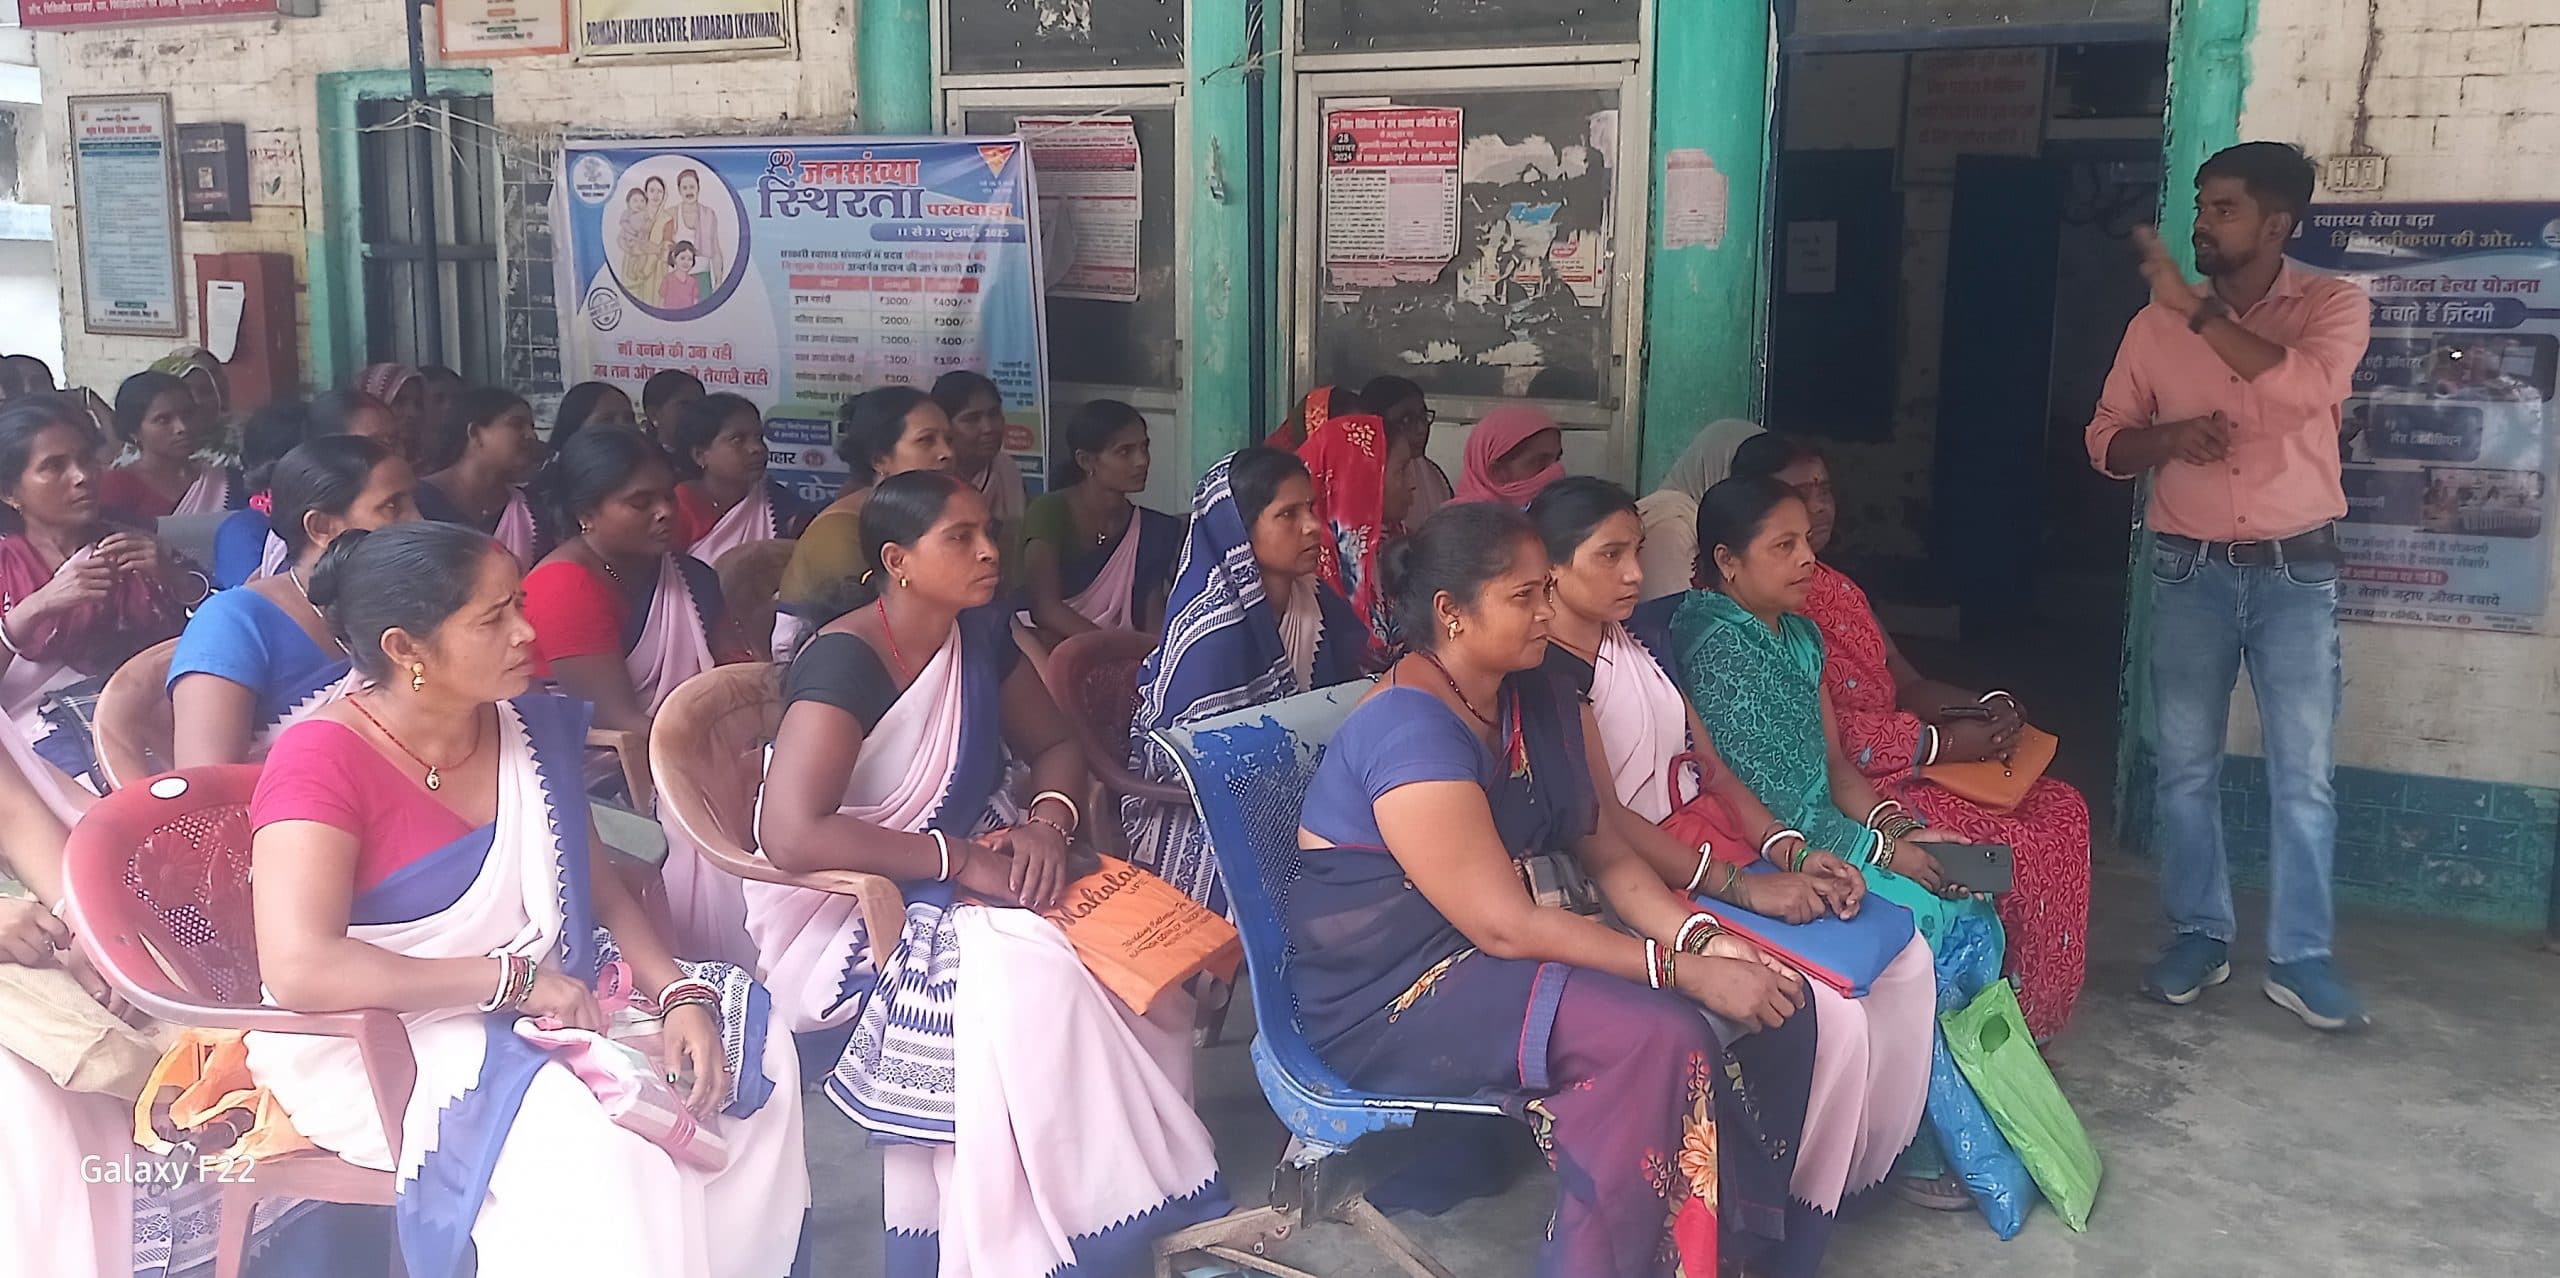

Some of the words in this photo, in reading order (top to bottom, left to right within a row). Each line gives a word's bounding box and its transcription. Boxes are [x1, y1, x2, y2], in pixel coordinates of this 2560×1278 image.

[624, 17, 654, 44] HEALTH
[690, 14, 733, 41] AMDABAD
[1338, 133, 1350, 144] 28
[799, 152, 920, 186] जनसंख्या
[758, 176, 925, 218] स्थिरता
[927, 203, 1013, 217] पखवाड़ा
[2313, 213, 2366, 228] स्वास्थ्य
[2369, 211, 2400, 228] सेवा
[912, 227, 922, 237] से
[2450, 230, 2474, 248] की
[2481, 275, 2542, 294] योजना
[2380, 302, 2420, 323] बचाते
[2426, 302, 2441, 323] हैं
[636, 341, 665, 358] बनने
[669, 341, 683, 358] की
[712, 343, 732, 361] वही
[744, 368, 768, 386] सही
